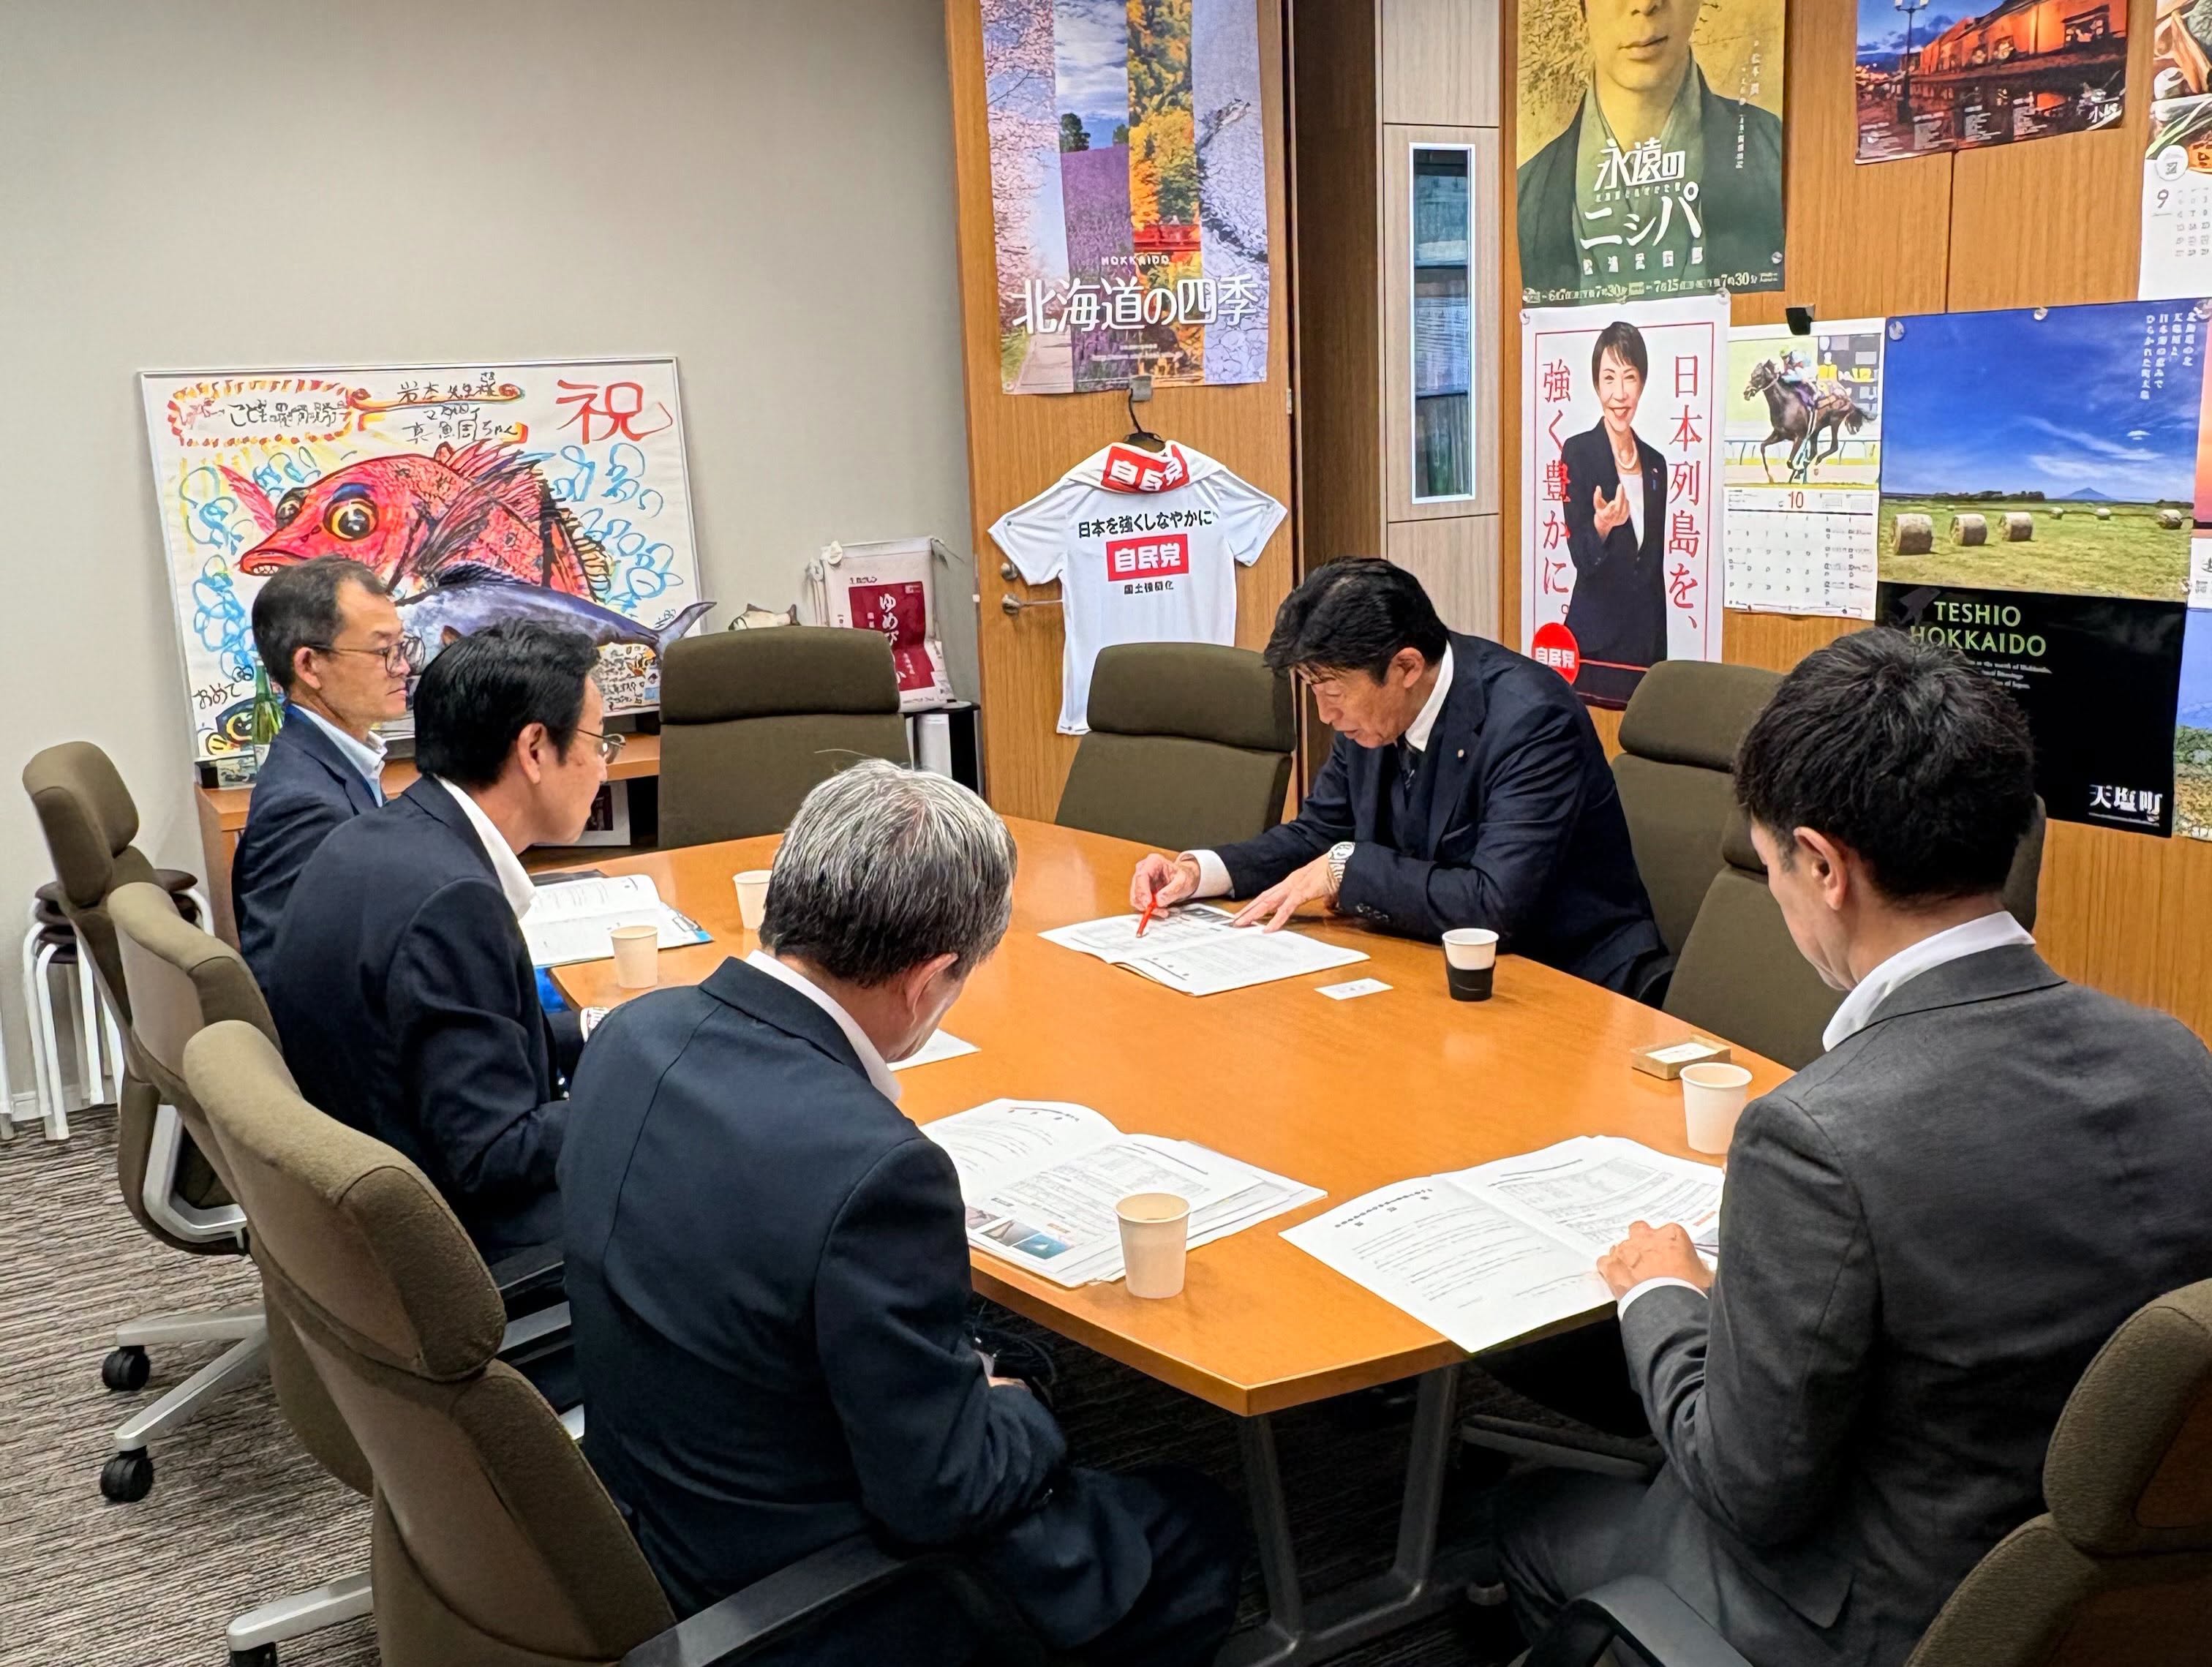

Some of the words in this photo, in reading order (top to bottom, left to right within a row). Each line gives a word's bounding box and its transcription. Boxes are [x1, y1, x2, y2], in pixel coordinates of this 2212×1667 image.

[1594, 137, 1685, 192] 永遠の
[2157, 189, 2169, 208] 9
[1580, 181, 1703, 249] ニシパ
[1012, 273, 1259, 334] 北海道の四季
[556, 379, 673, 444] 祝
[1542, 358, 1572, 616] 強く豊かに。
[1669, 354, 1703, 629] 日本列島を、
[1788, 491, 1804, 509] 10
[1078, 509, 1213, 538] 日本を強くしなやかに
[1114, 543, 1181, 573] 自民党
[1933, 601, 2021, 628] TESHIO
[1910, 625, 2047, 657] HOKKAIDO
[2089, 784, 2163, 816] 天塩町
